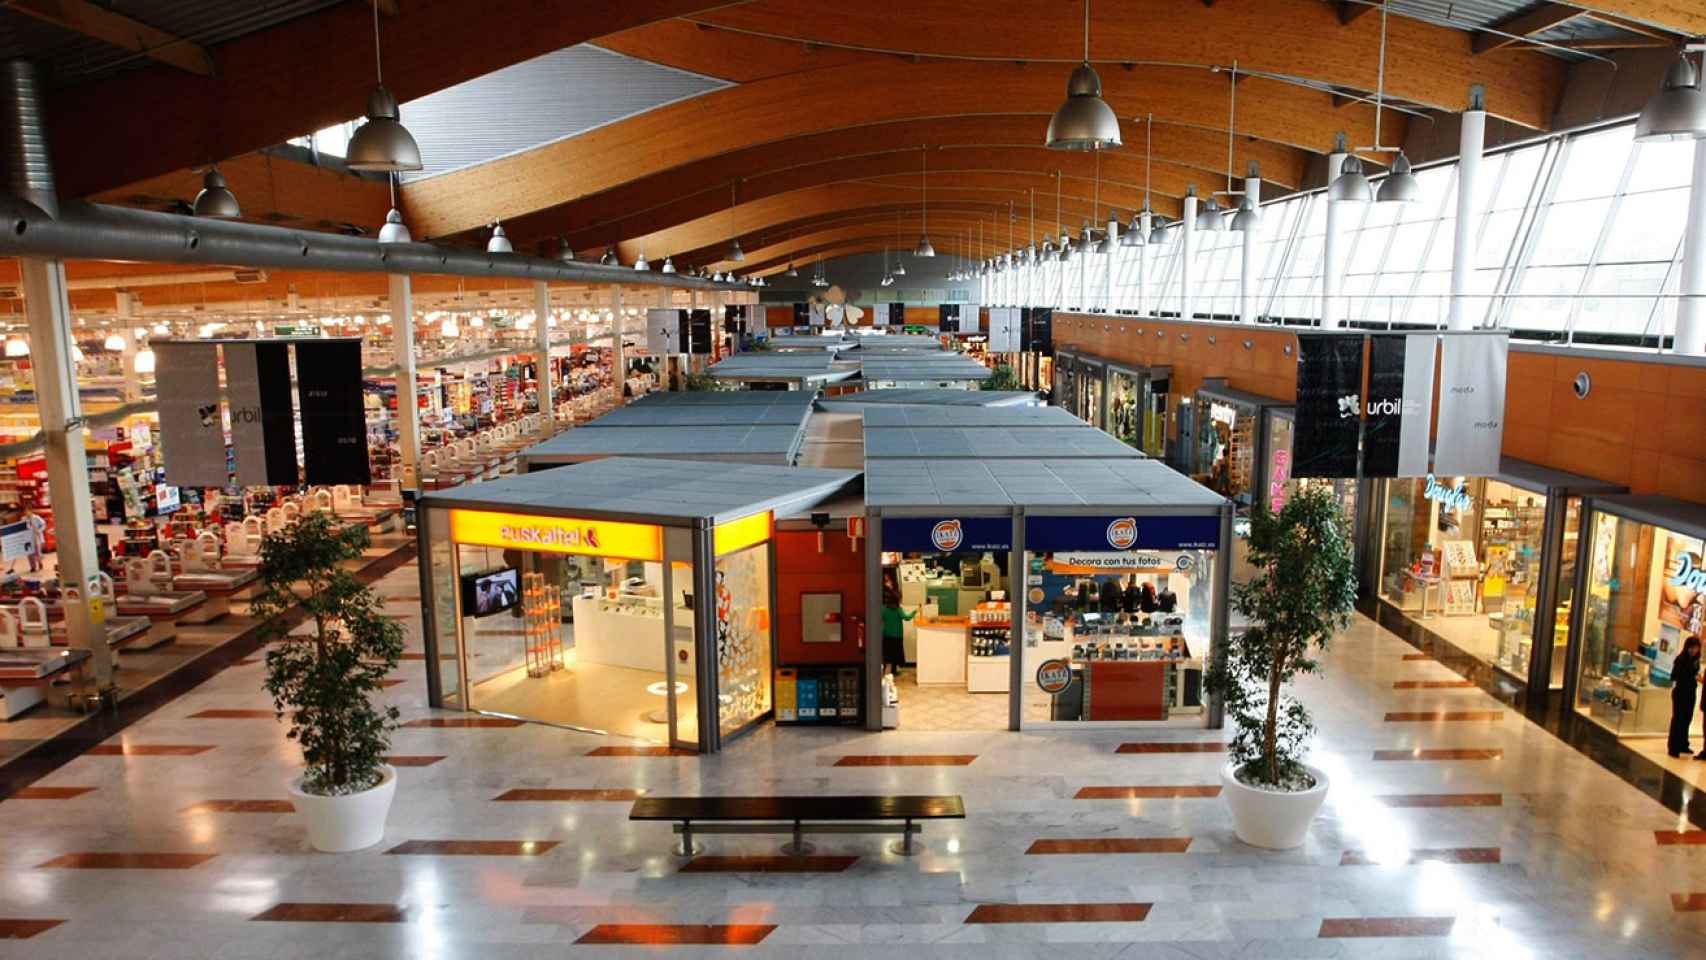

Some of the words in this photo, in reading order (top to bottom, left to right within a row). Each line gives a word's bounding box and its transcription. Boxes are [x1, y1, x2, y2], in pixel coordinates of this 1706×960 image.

[1367, 398, 1402, 415] urbil
[1473, 420, 1498, 430] moda
[500, 525, 580, 546] euskaltel
[1069, 557, 1101, 566] Decora
[1122, 557, 1136, 565] tus
[1138, 556, 1161, 565] fotos
